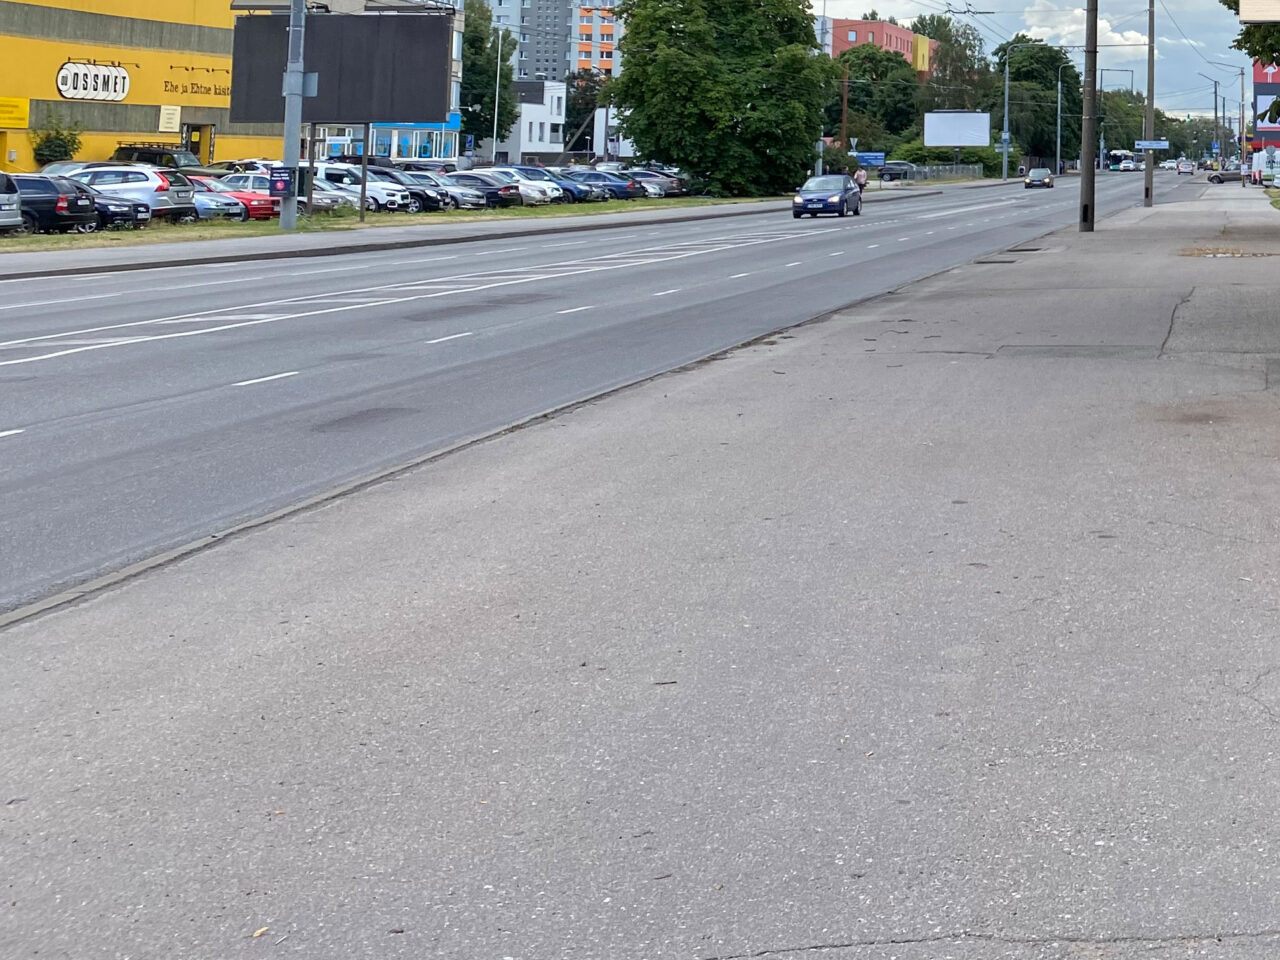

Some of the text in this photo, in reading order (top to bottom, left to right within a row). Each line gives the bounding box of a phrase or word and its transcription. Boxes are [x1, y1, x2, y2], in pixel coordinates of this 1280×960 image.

[72, 72, 127, 94] OSSMET
[164, 81, 178, 93] Ehe
[180, 83, 188, 95] ja
[213, 84, 231, 96] käsit
